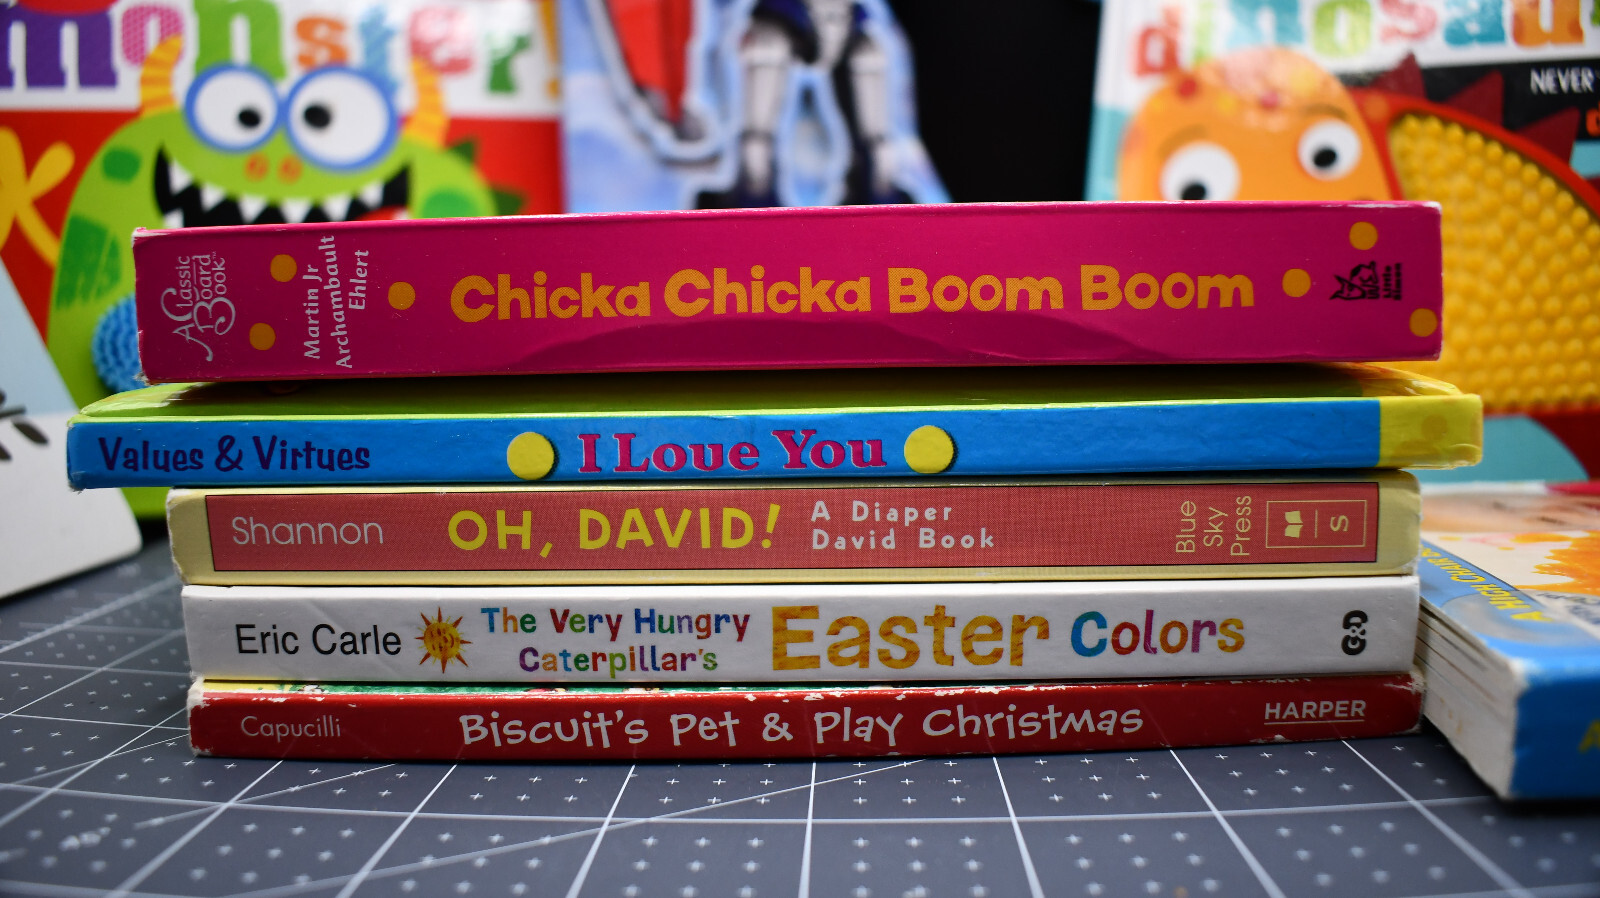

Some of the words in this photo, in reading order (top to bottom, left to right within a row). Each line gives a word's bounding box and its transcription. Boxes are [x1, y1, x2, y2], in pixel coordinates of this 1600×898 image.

[1530, 67, 1594, 95] NEVER
[161, 255, 193, 322] Classic
[302, 263, 322, 282] Jr
[348, 249, 370, 310] Ehlert
[450, 270, 651, 323] Chicka
[663, 264, 872, 318] Chicka
[887, 266, 1064, 314] Boom
[1080, 263, 1255, 312] Boom
[318, 235, 354, 369] Archambault
[303, 288, 321, 360] Martin
[98, 436, 205, 472] Values
[214, 434, 244, 472] &
[252, 435, 371, 471] Virtues
[578, 433, 602, 473] I
[771, 429, 888, 469] You
[231, 516, 384, 545] Shannon
[447, 508, 553, 558] OH,
[579, 503, 782, 550] DAVID!
[810, 500, 831, 522] A
[852, 501, 953, 528] Diaper
[1175, 500, 1197, 553] Blue
[1203, 506, 1229, 547] Sky
[1230, 495, 1252, 556] Press
[812, 528, 897, 551] David
[919, 528, 995, 550] Book
[235, 624, 300, 656] Eric
[311, 623, 402, 656] Carle
[480, 607, 537, 634] The
[549, 607, 623, 643] Very
[633, 606, 751, 643] Hungry
[771, 604, 1050, 671] Easter
[1070, 609, 1246, 658] Colors
[518, 646, 719, 679] Caterpillar's
[239, 714, 342, 742] Capucilli
[459, 709, 650, 749] Biscuit's
[670, 711, 741, 748] Pet
[761, 711, 794, 743] &
[814, 706, 904, 747] Play
[1264, 700, 1367, 720] HARPER
